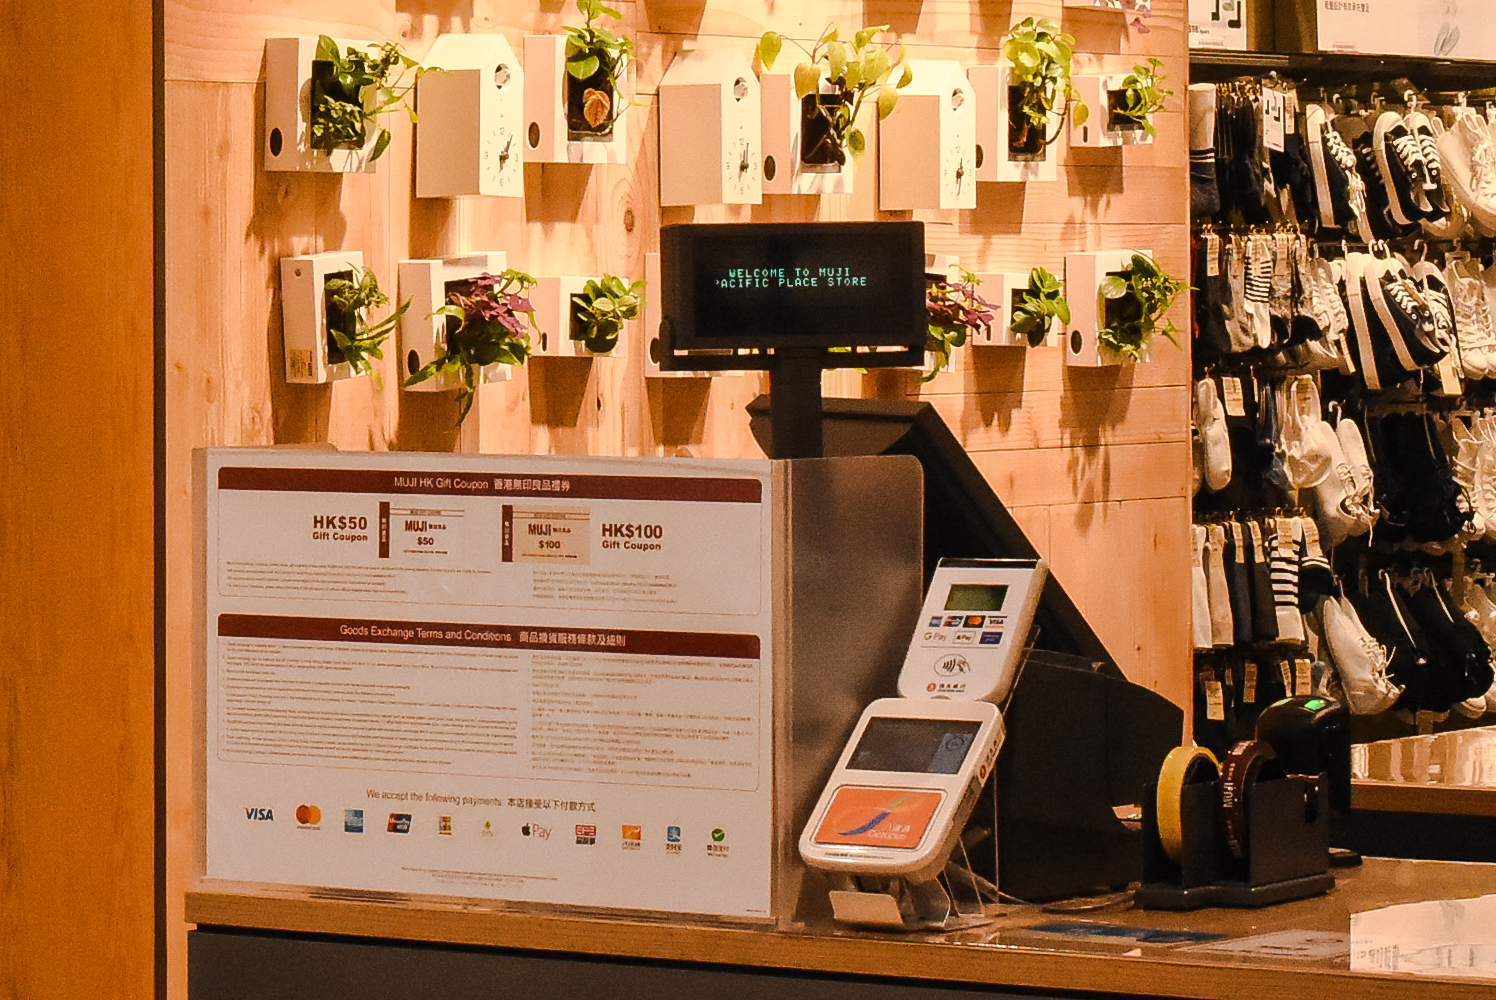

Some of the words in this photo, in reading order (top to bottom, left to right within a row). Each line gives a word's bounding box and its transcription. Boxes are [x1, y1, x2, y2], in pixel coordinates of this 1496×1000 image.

[729, 268, 785, 278] WELCOME
[795, 268, 810, 277] TO
[819, 267, 850, 277] MUJI
[716, 278, 769, 288] ACIFIC
[778, 278, 818, 287] PLACE
[827, 277, 867, 287] STORE
[394, 476, 417, 487] MUJI
[419, 477, 434, 488] HK
[435, 478, 452, 489] Gift
[453, 479, 489, 492] Coupon
[312, 515, 368, 531] HK$50
[404, 520, 427, 532] MUJI
[528, 523, 551, 536] MUJI
[312, 531, 330, 541] Gift
[332, 532, 368, 543] Coupon
[601, 523, 663, 539] HK$100
[417, 536, 435, 546] $50
[538, 540, 561, 549] $100
[602, 540, 621, 550] Gift
[623, 541, 662, 552] Coupon
[339, 625, 369, 636] Goods
[371, 626, 414, 640] Exchange
[416, 628, 443, 640] Terms
[445, 629, 462, 640] and
[464, 630, 512, 642] Conditions
[933, 633, 947, 644] Pay
[366, 789, 380, 799] We
[382, 790, 409, 802] accept
[410, 791, 424, 801] the
[425, 792, 461, 806] following
[462, 795, 502, 807] payments
[1223, 782, 1234, 808] MUJI
[245, 807, 274, 821] VISA
[532, 823, 553, 840] Pay
